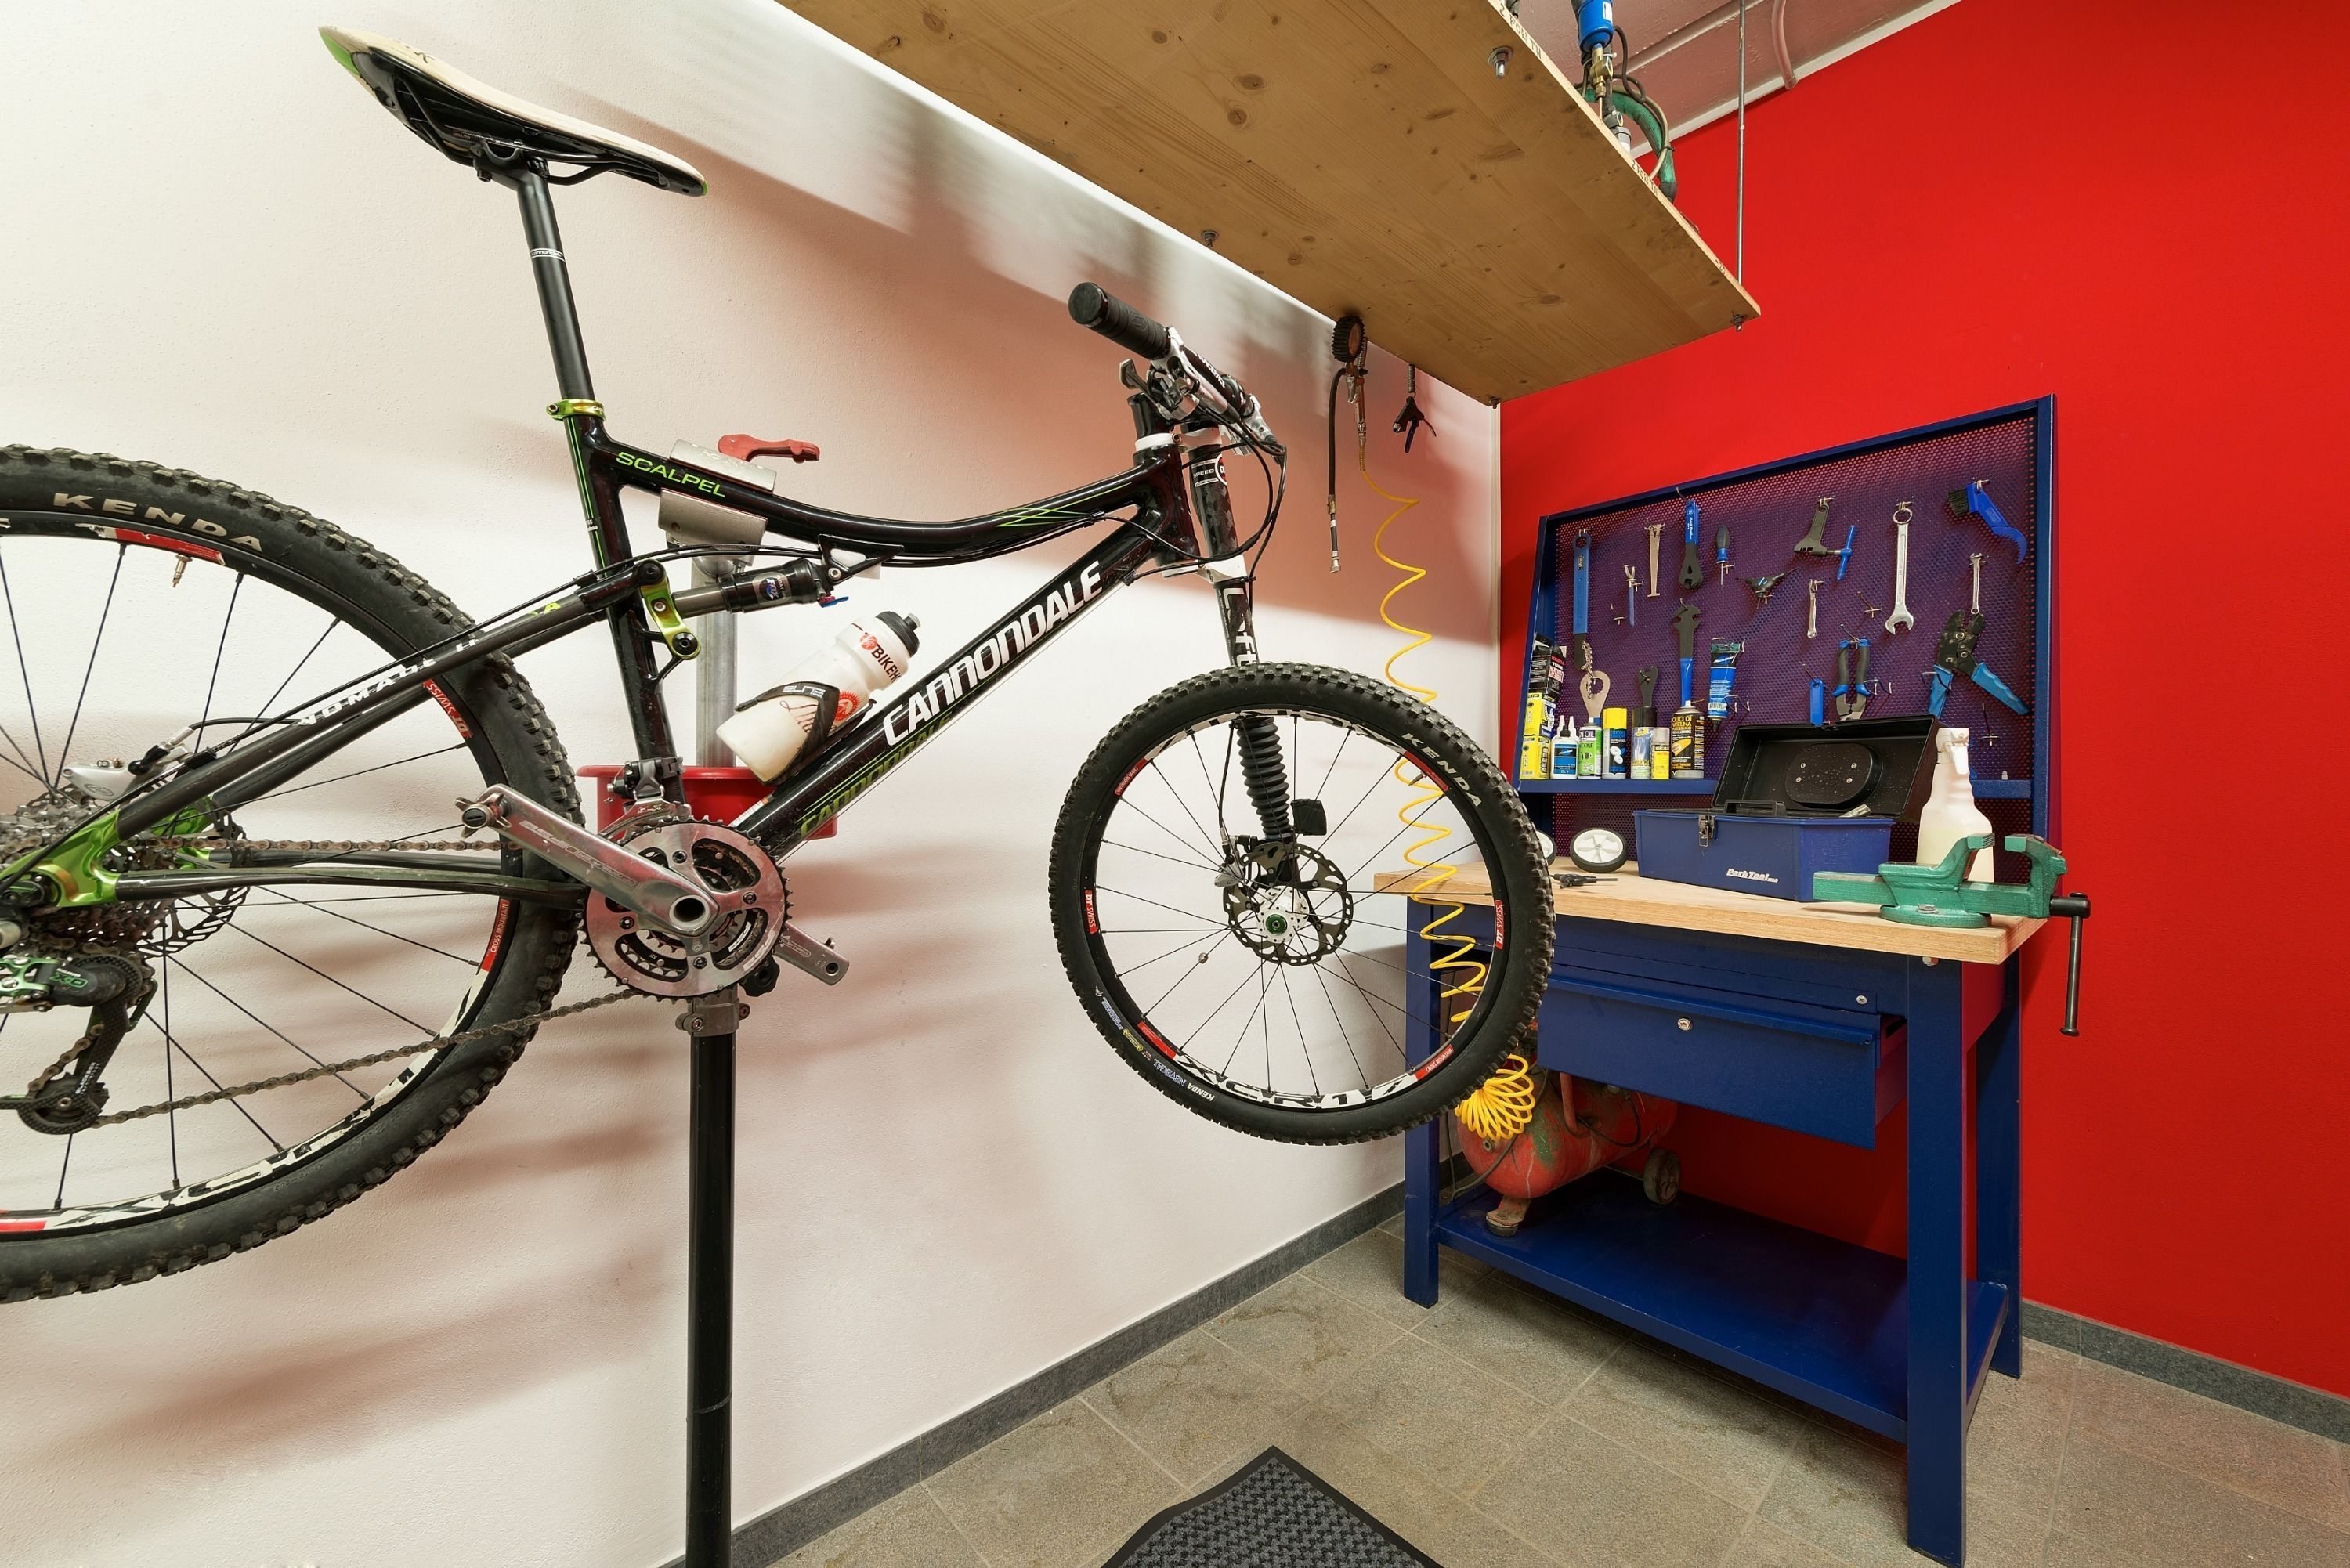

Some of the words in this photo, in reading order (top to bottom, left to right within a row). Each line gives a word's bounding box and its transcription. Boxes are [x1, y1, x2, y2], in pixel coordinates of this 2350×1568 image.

[616, 451, 726, 498] SCALPEL
[1193, 468, 1214, 479] SPEED
[52, 493, 262, 552] KENDA
[428, 682, 457, 716] SWISS
[1401, 732, 1482, 807] KENDA
[1726, 868, 1748, 879] Park
[1748, 871, 1770, 882] Tool
[1086, 907, 1097, 928] SWISS
[1495, 904, 1504, 929] SWISS
[490, 934, 501, 953] CROSS
[1495, 929, 1504, 944] DT
[1426, 1060, 1437, 1073] CROSS
[1187, 1082, 1216, 1102] KENDA
